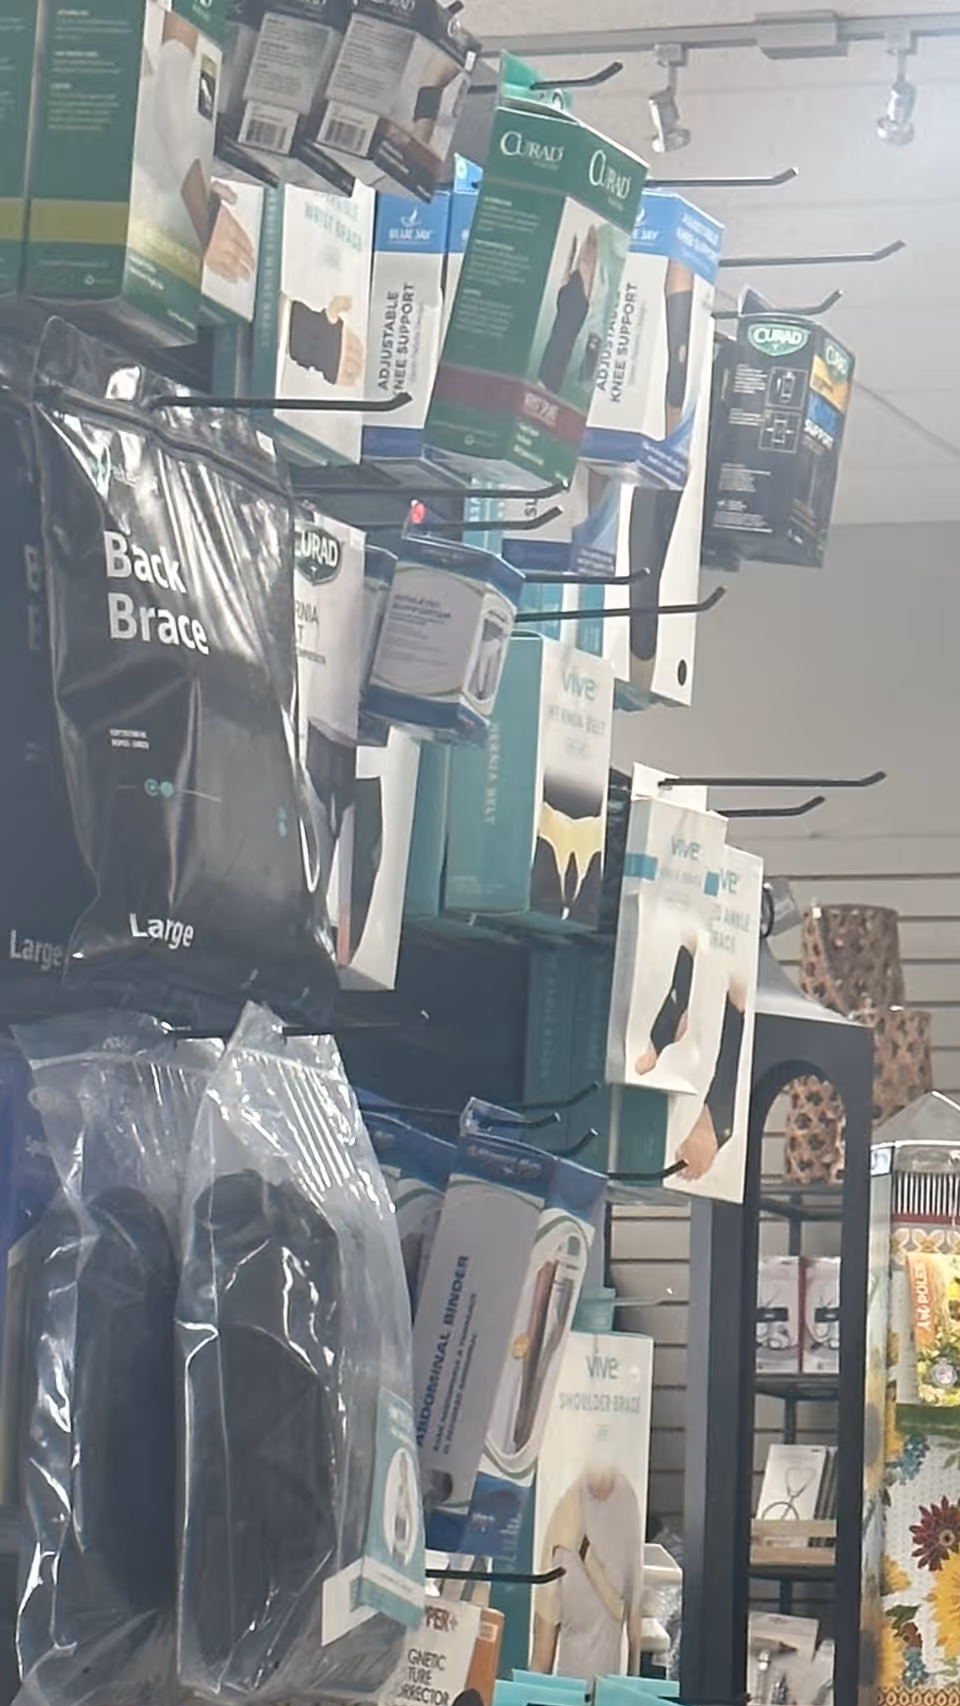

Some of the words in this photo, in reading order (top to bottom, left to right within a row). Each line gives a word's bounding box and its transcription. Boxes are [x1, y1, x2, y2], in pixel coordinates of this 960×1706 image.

[396, 282, 416, 355] SUPPORT
[617, 282, 639, 356] SUPPORT
[753, 327, 802, 344] CURAD
[378, 290, 400, 391] ADJUSTABLE
[609, 360, 627, 403] KNEE
[103, 530, 188, 594] Back
[107, 592, 210, 655] Brace
[295, 600, 319, 625] RNIA
[9, 929, 64, 970] Large
[130, 912, 195, 950] Large
[415, 1332, 451, 1450] ABDOMINAL
[443, 1253, 470, 1329] BINDER
[425, 1604, 458, 1633] PER+
[407, 1648, 447, 1671] GNETIC
[408, 1666, 433, 1687] TURE
[397, 1683, 450, 1706] RRECTOR
